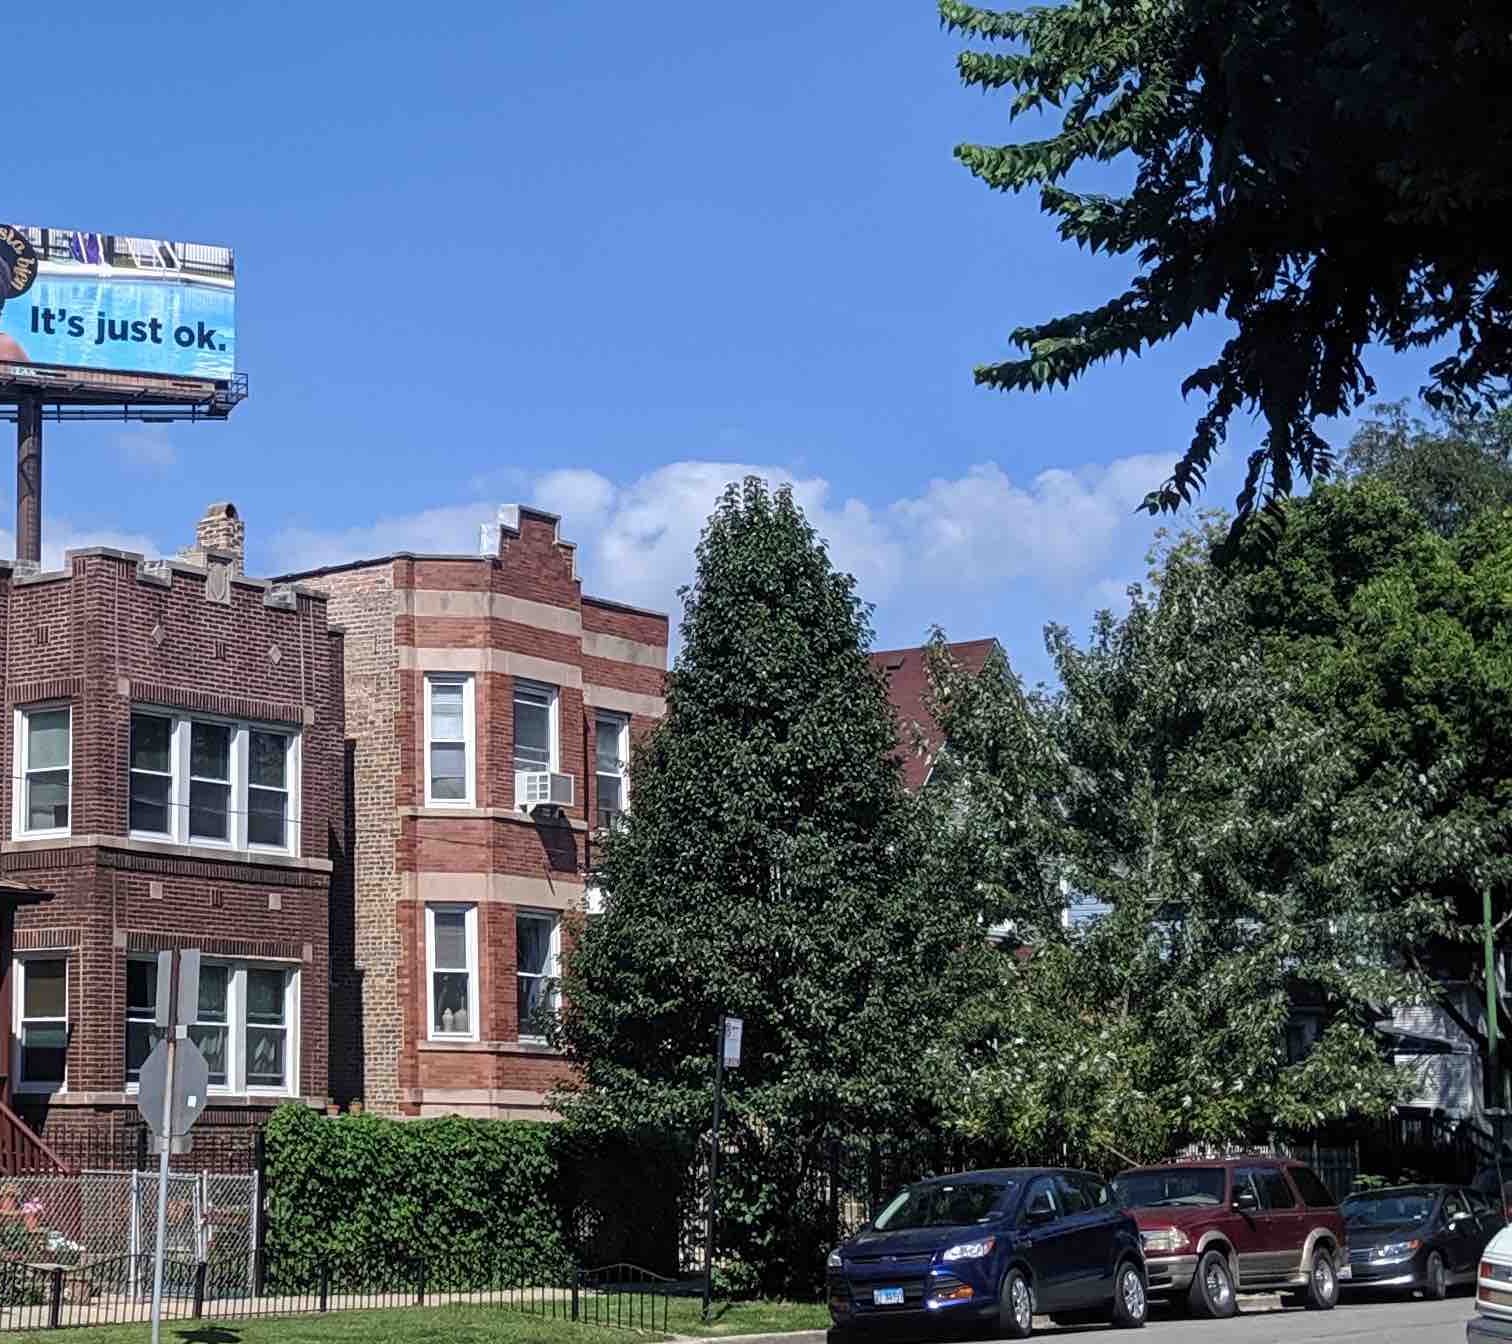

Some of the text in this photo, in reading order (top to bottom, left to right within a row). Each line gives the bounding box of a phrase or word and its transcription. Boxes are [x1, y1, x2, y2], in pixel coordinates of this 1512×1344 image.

[10, 256, 35, 290] bien
[31, 306, 226, 351] It's just ok.
